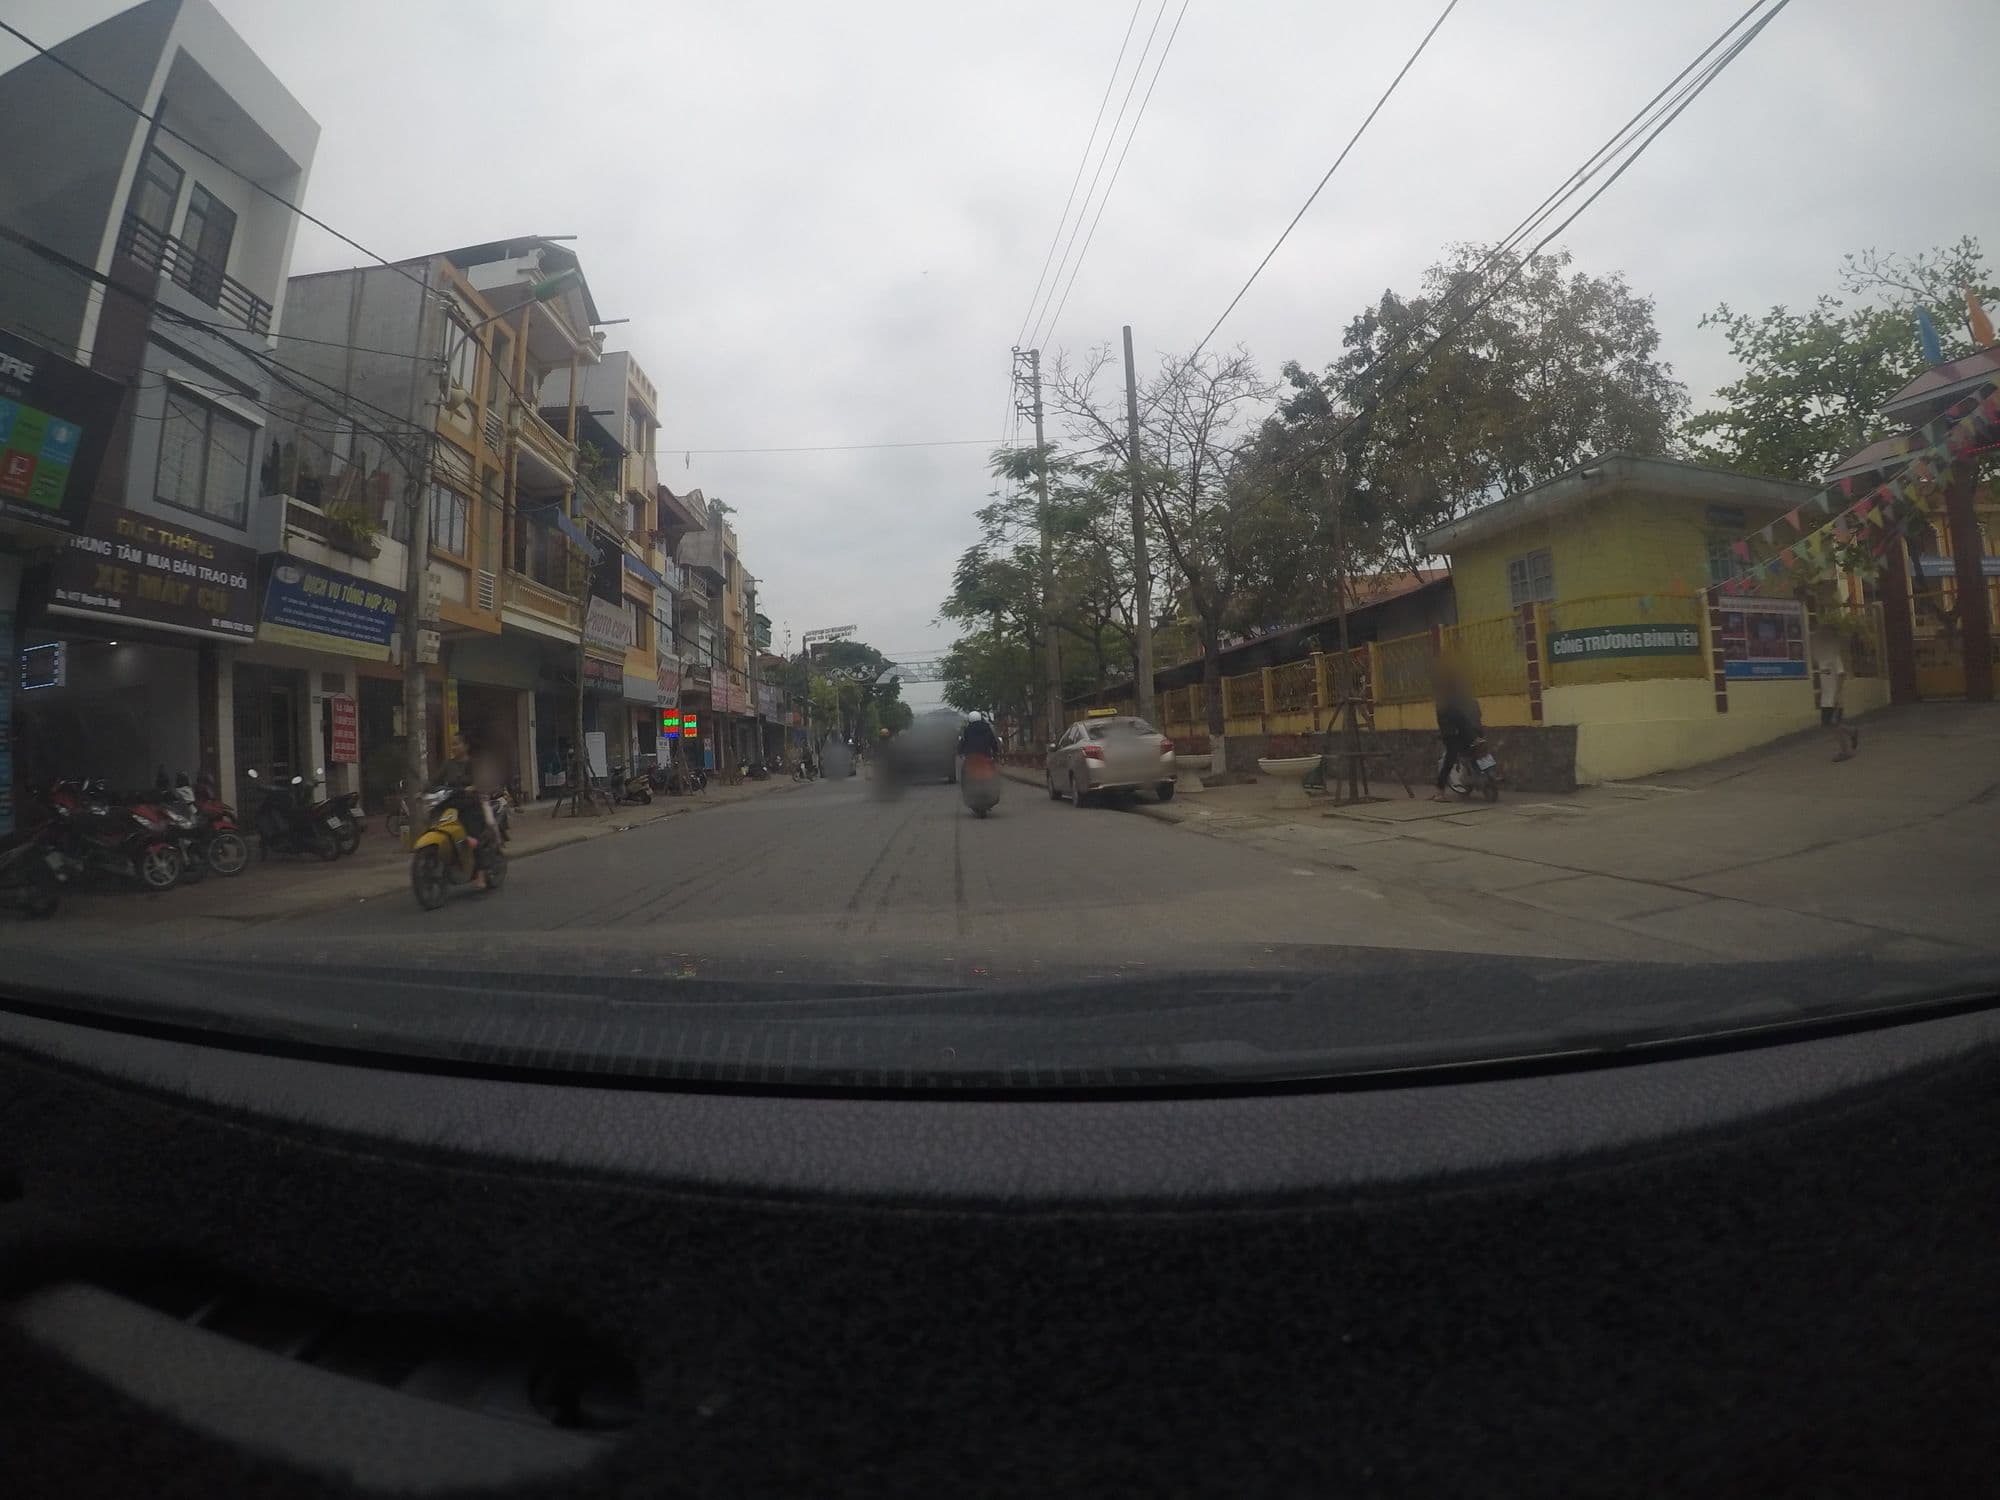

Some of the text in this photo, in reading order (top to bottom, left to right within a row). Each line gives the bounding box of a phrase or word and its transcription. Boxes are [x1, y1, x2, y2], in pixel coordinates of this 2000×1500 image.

[116, 544, 143, 564] TÂM
[146, 553, 171, 571] MUA
[173, 559, 197, 577] BÁN
[198, 566, 228, 585] TRAO
[1553, 632, 1584, 655] CỔNG
[1584, 629, 1643, 652] TRƯỜNG
